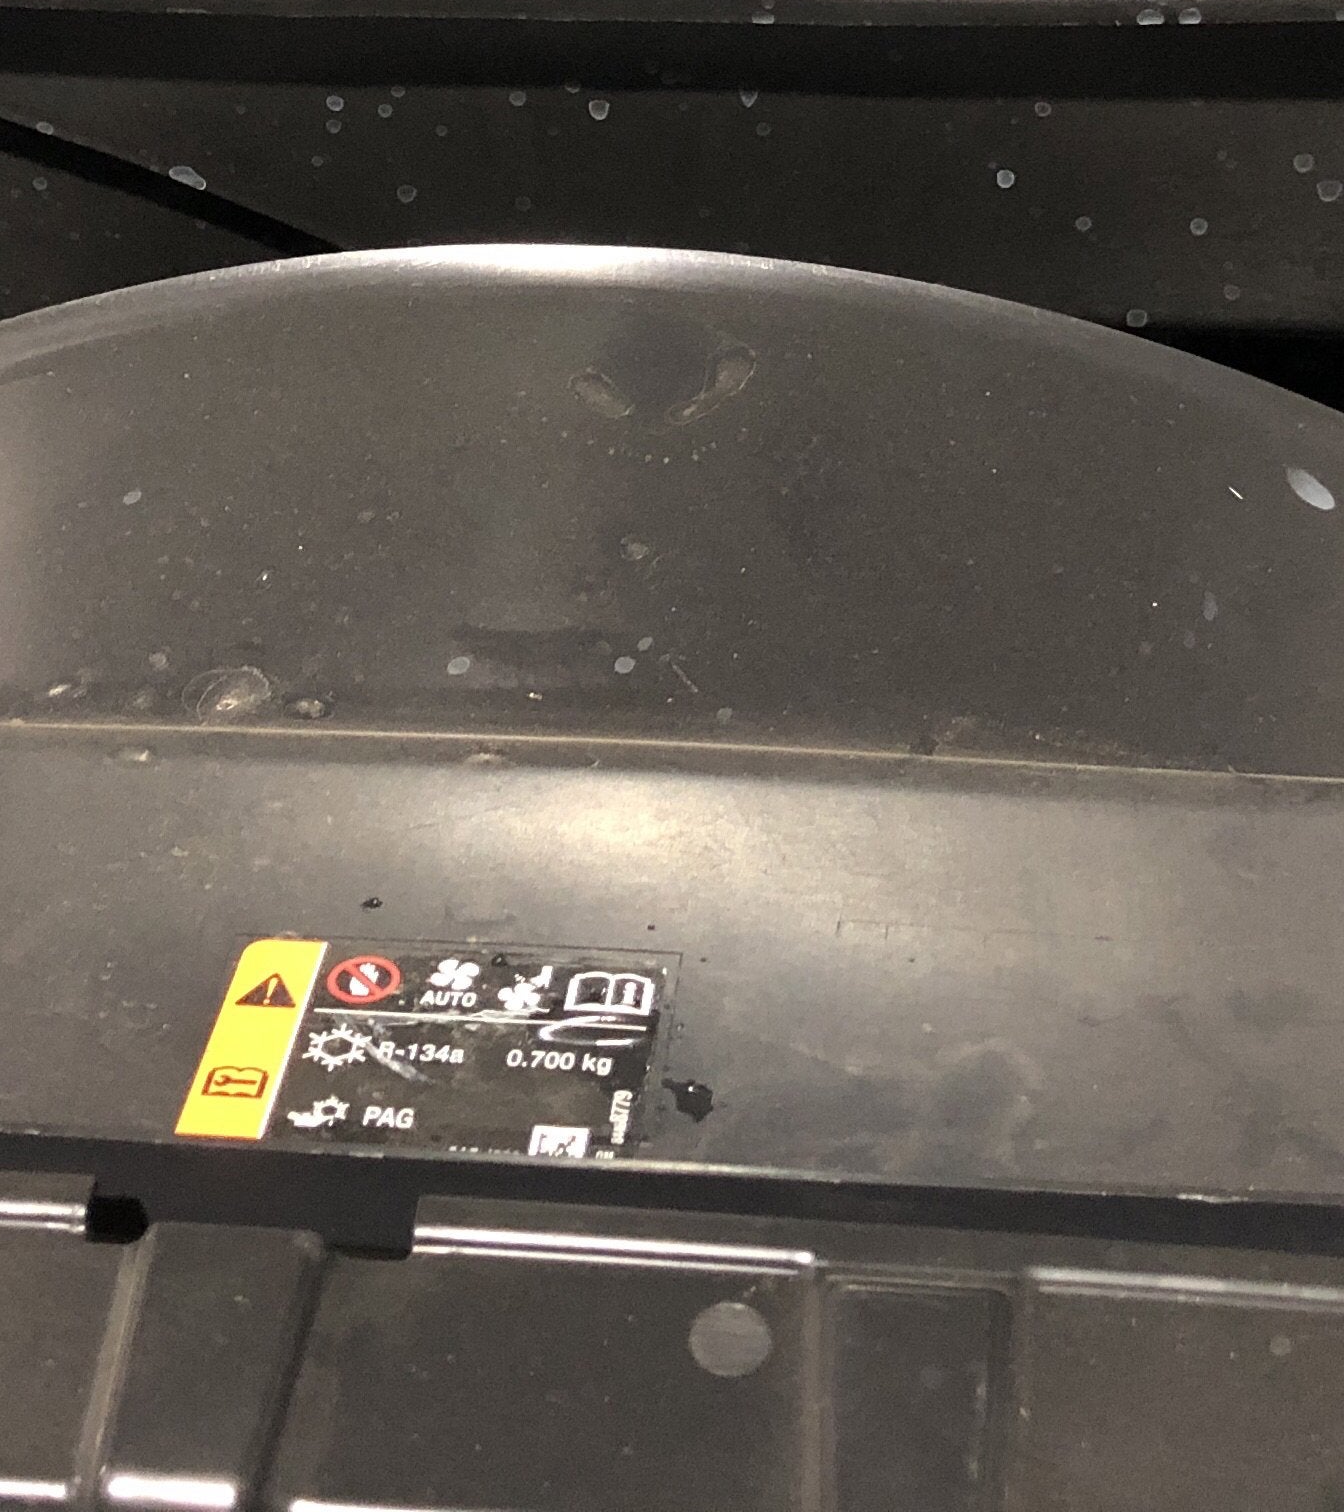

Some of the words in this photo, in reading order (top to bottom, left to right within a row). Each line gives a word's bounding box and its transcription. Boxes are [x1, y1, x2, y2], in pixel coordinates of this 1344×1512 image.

[419, 991, 477, 1008] AUTO
[375, 1040, 465, 1064] R-134a
[506, 1049, 576, 1071] 0.700
[582, 1054, 613, 1076] kg
[363, 1106, 415, 1129] PAG
